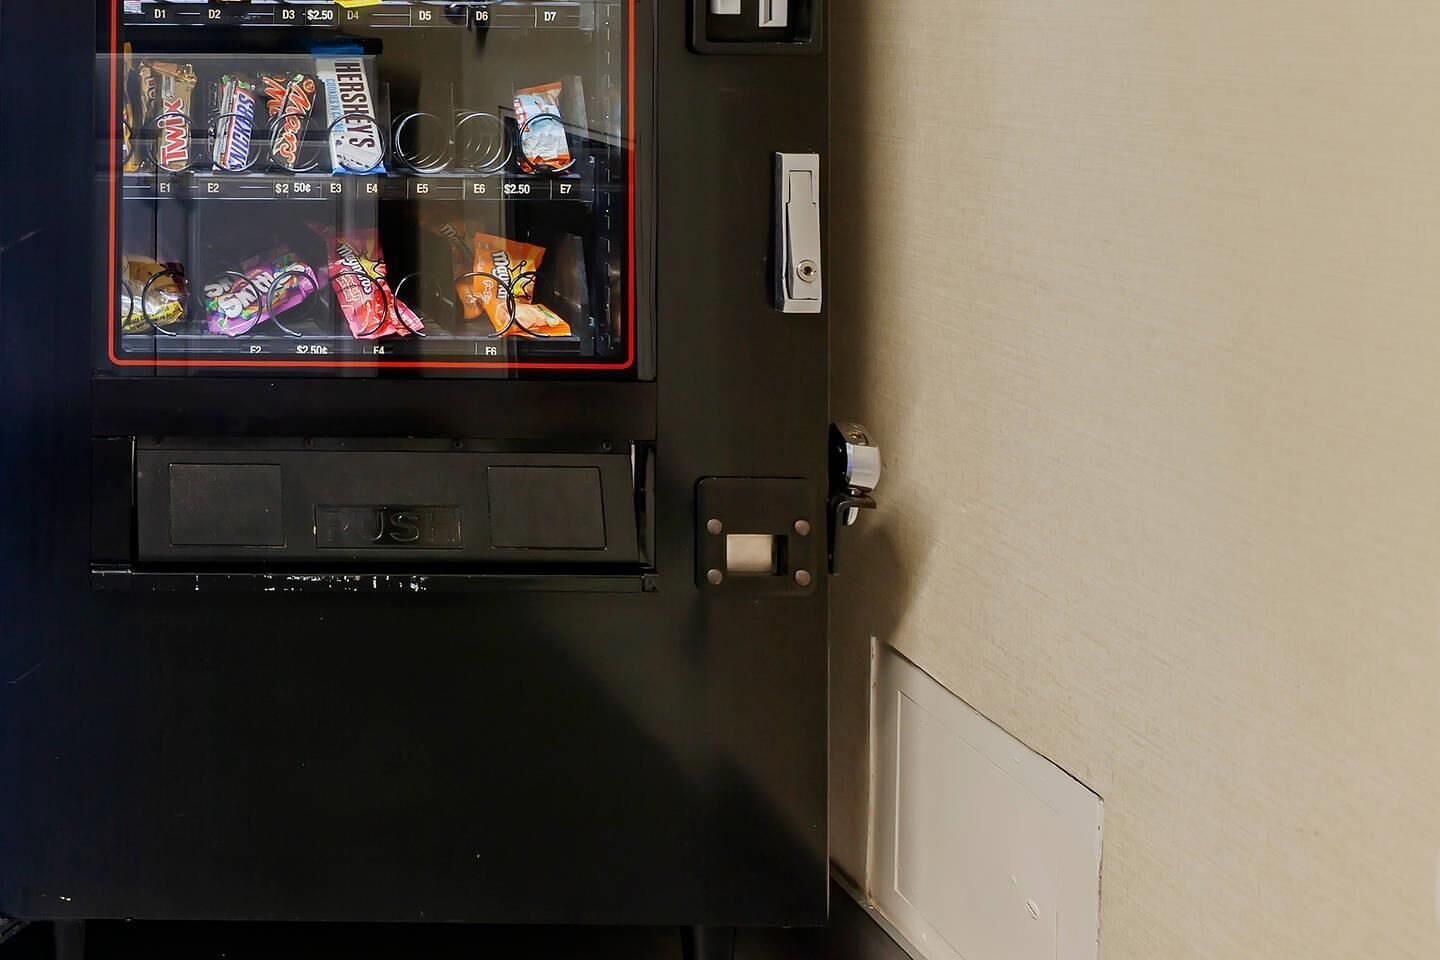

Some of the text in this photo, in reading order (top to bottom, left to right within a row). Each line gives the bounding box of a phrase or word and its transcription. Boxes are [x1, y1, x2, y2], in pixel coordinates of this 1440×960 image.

[154, 9, 166, 18] D1
[208, 9, 221, 19] D2
[282, 9, 296, 19] D3
[307, 9, 334, 20] $2.50
[347, 10, 360, 20] D4
[418, 10, 432, 21] D5
[475, 11, 489, 21] D6
[544, 11, 557, 21] D7
[334, 62, 376, 149] HERSHEY'S
[160, 182, 171, 193] E1
[207, 182, 220, 193] E2
[330, 183, 342, 193] E3
[366, 183, 378, 193] E4
[416, 183, 429, 193] E5
[473, 183, 486, 194] E6
[503, 183, 531, 194] $2.50
[560, 184, 572, 194] E7
[372, 345, 385, 355] F4
[485, 346, 497, 356] F6
